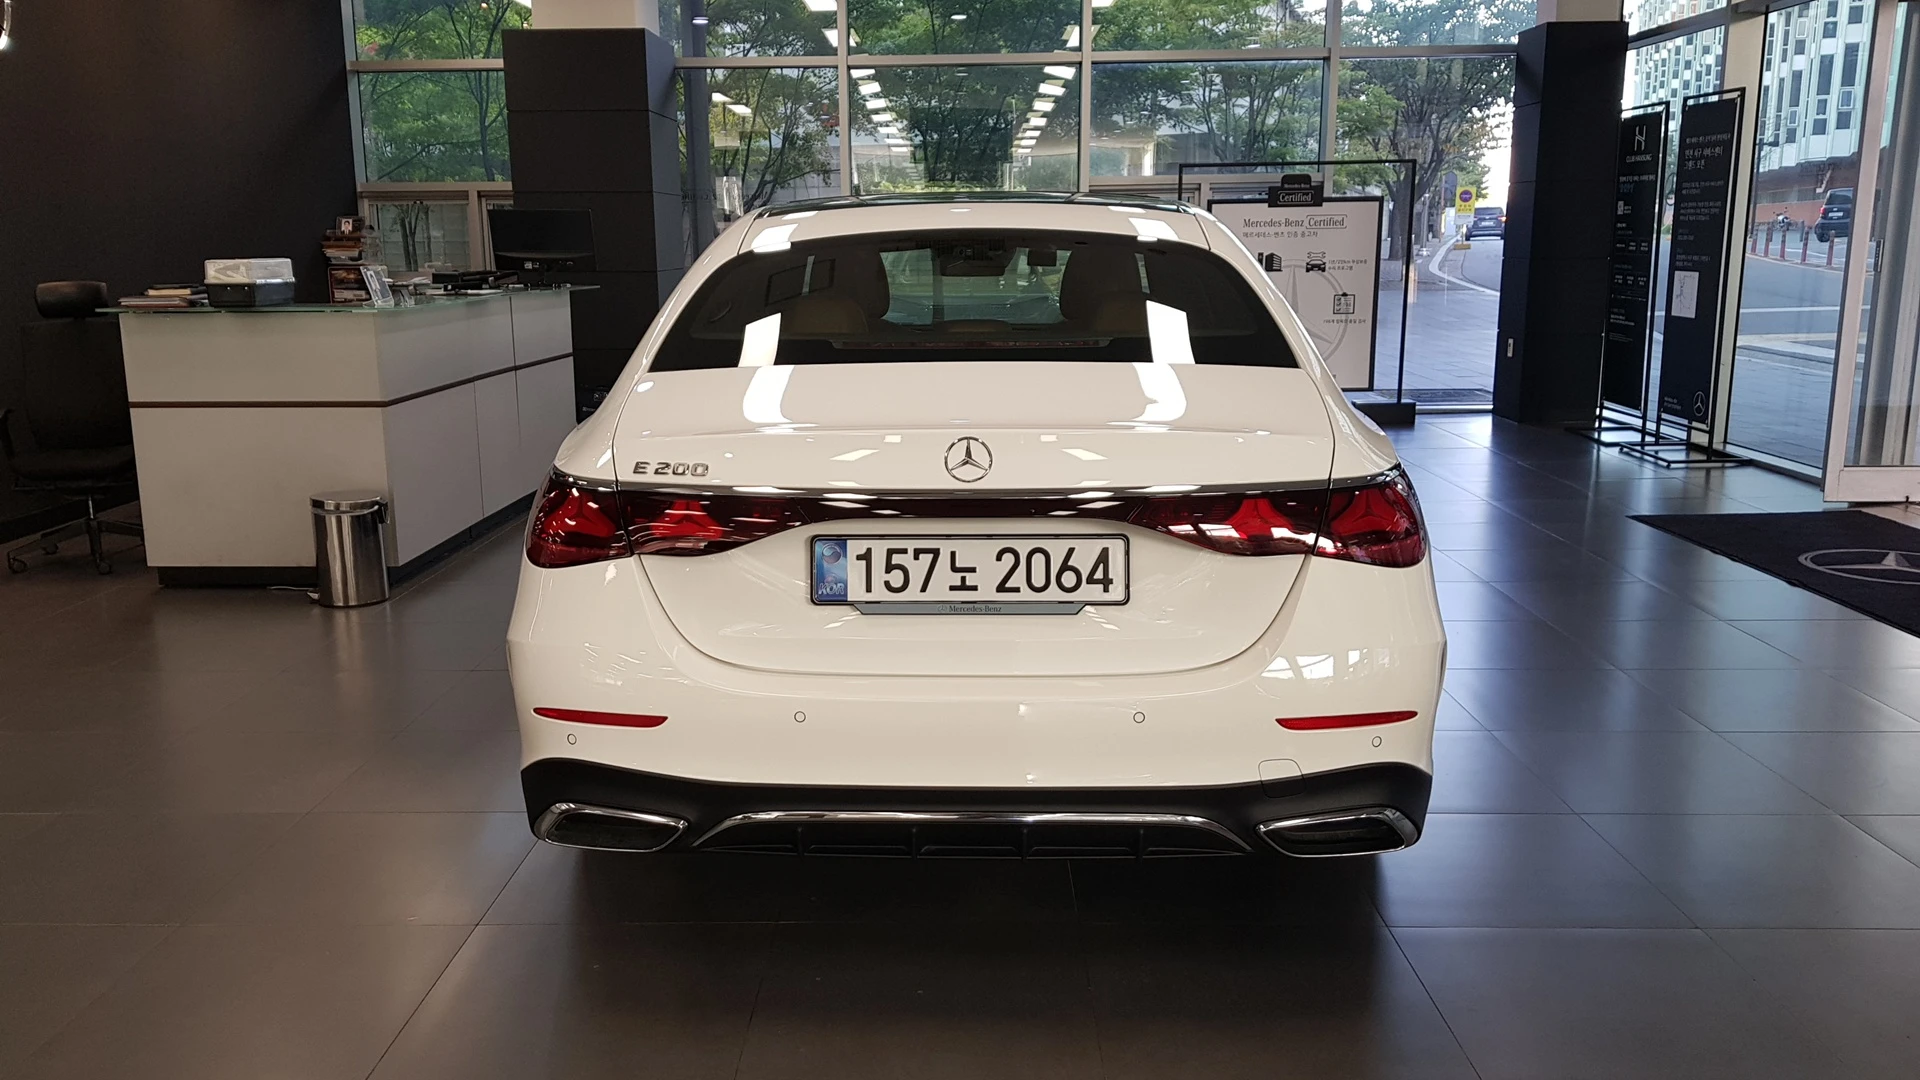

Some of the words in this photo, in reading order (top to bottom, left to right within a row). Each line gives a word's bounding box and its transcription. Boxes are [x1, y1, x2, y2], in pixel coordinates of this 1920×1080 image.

[1279, 192, 1312, 202] Certified
[1242, 217, 1305, 228] Mercedes-Benz
[1308, 217, 1345, 227] Certified
[632, 461, 651, 474] E
[653, 461, 709, 477] 200
[855, 546, 979, 594] 157노
[995, 546, 1114, 594] 2064
[818, 582, 845, 595] KOR
[948, 604, 1002, 613] Mercedes-Benz
